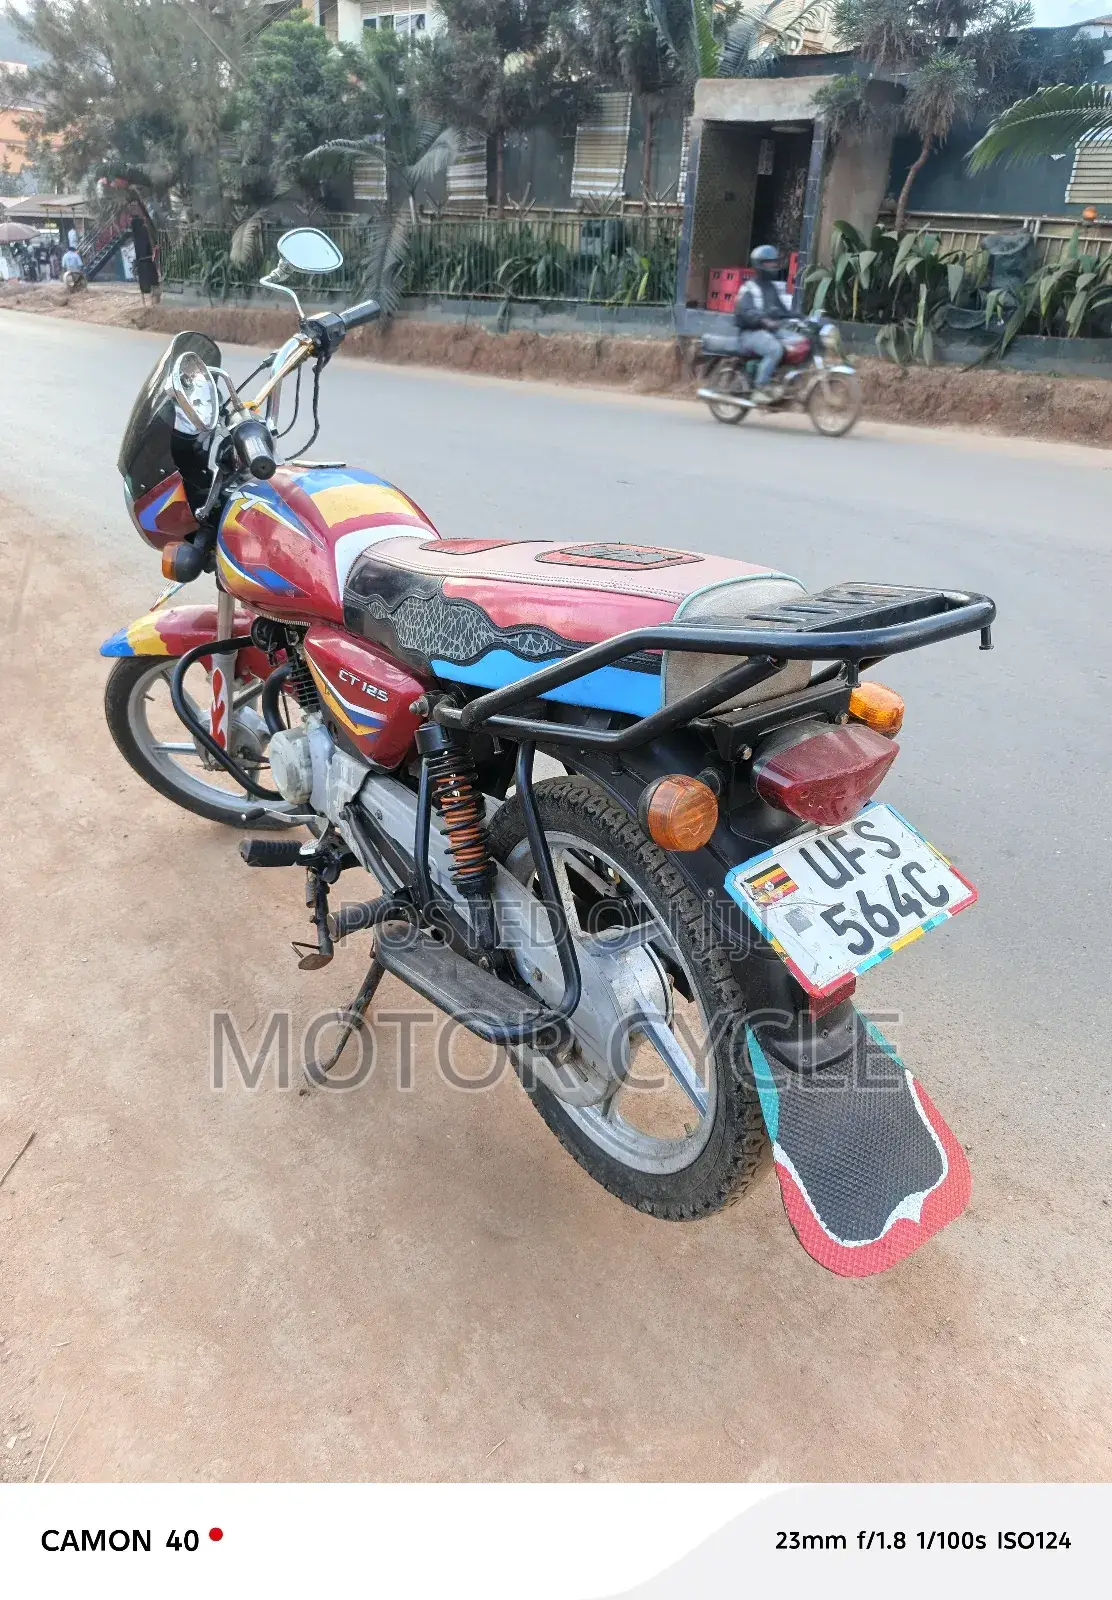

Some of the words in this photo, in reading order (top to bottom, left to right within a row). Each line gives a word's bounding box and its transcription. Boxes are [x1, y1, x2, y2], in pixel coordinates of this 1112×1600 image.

[339, 669, 360, 686] CT
[362, 681, 389, 702] 125
[799, 820, 901, 889] UFS
[819, 861, 950, 955] 564C
